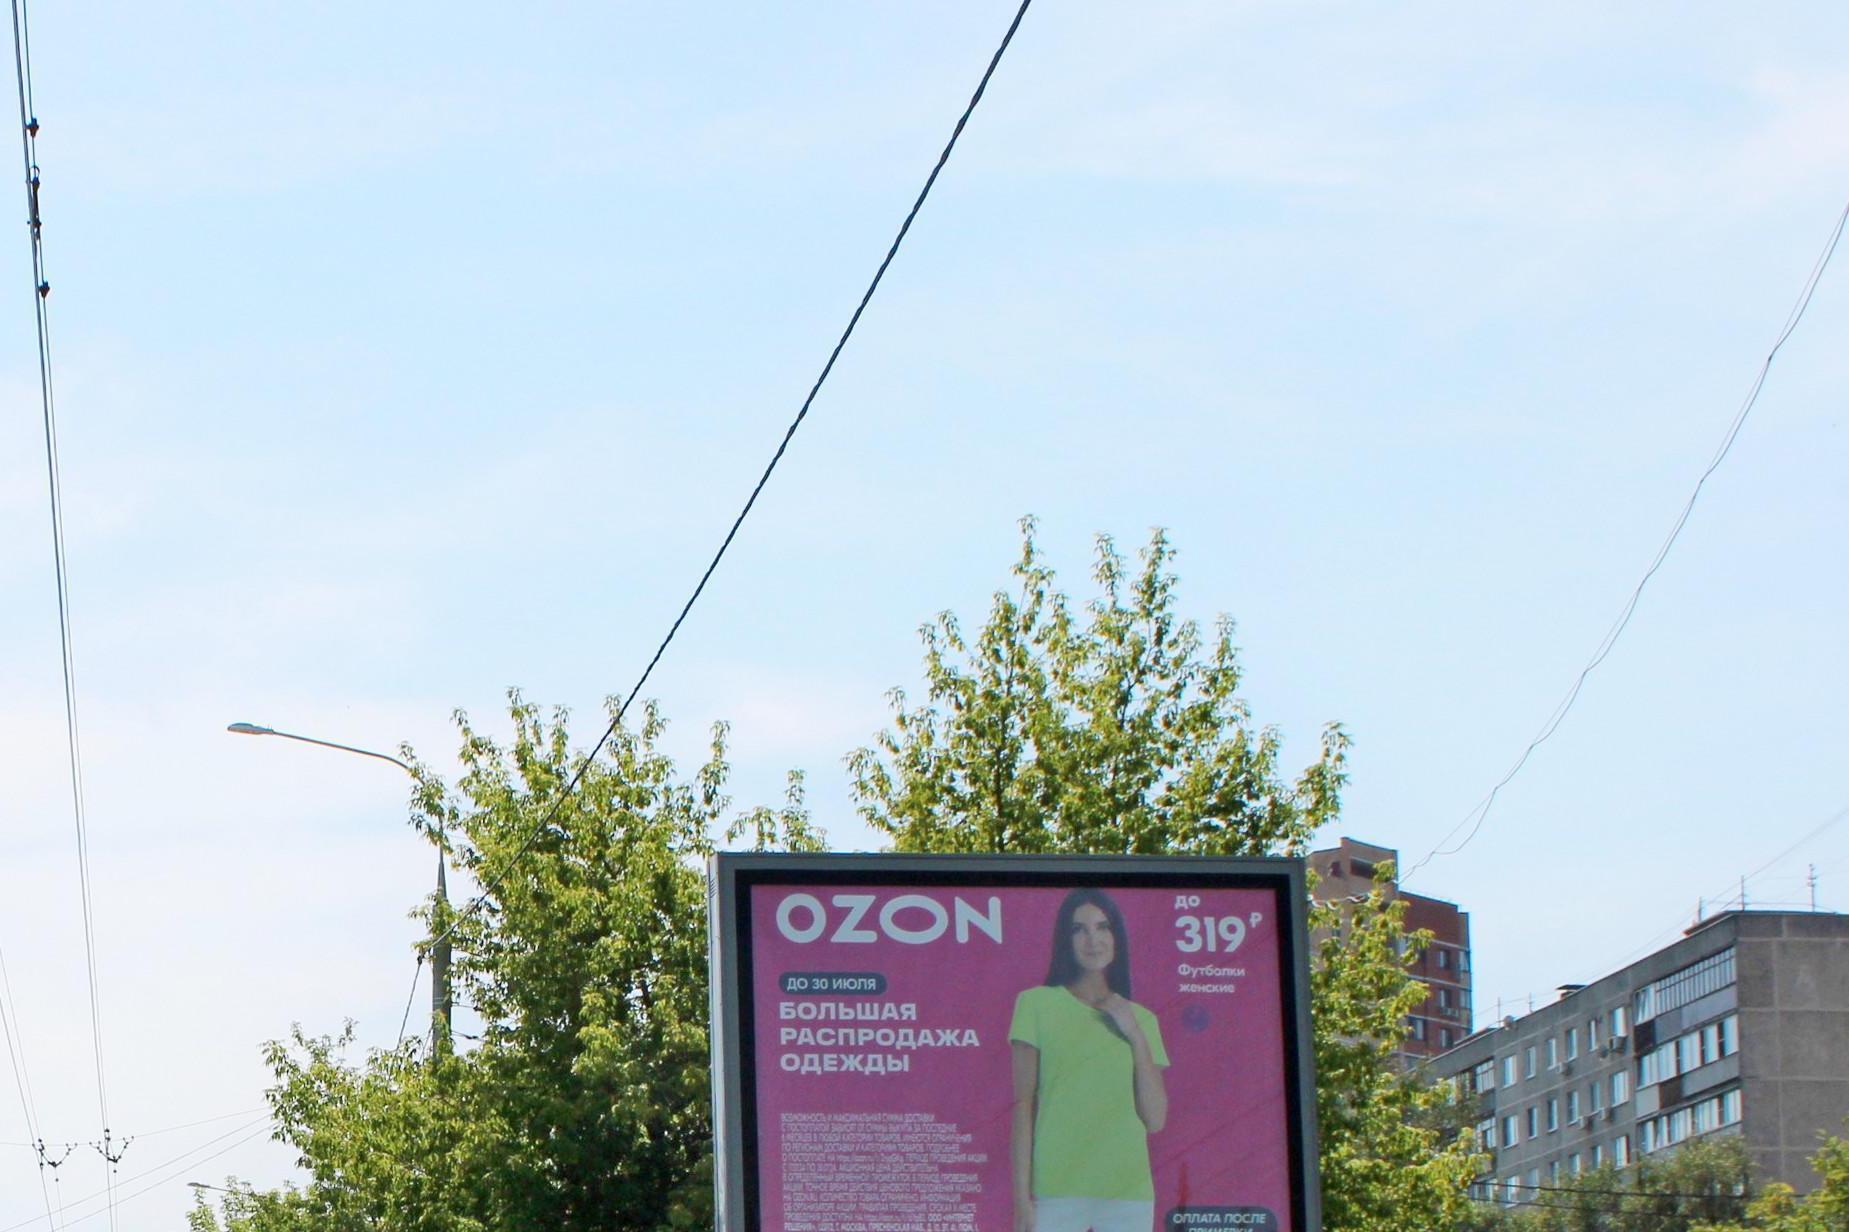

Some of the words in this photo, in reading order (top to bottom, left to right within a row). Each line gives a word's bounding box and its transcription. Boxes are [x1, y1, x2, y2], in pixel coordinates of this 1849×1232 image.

[776, 893, 1003, 944] OZON
[1178, 963, 1246, 978] Футболки
[787, 977, 808, 991] ДО
[812, 978, 829, 990] 30
[832, 978, 877, 990] ИЮЛЯ
[1179, 983, 1236, 993] женские
[779, 1001, 917, 1021] БОЛЬШАЯ
[779, 1027, 980, 1050] РАСПРОДАЖА
[780, 1053, 910, 1075] ОДЕЖДЫ
[1172, 1213, 1222, 1224] ОПЛАТА
[1224, 1213, 1267, 1224] ПОСЛЕ
